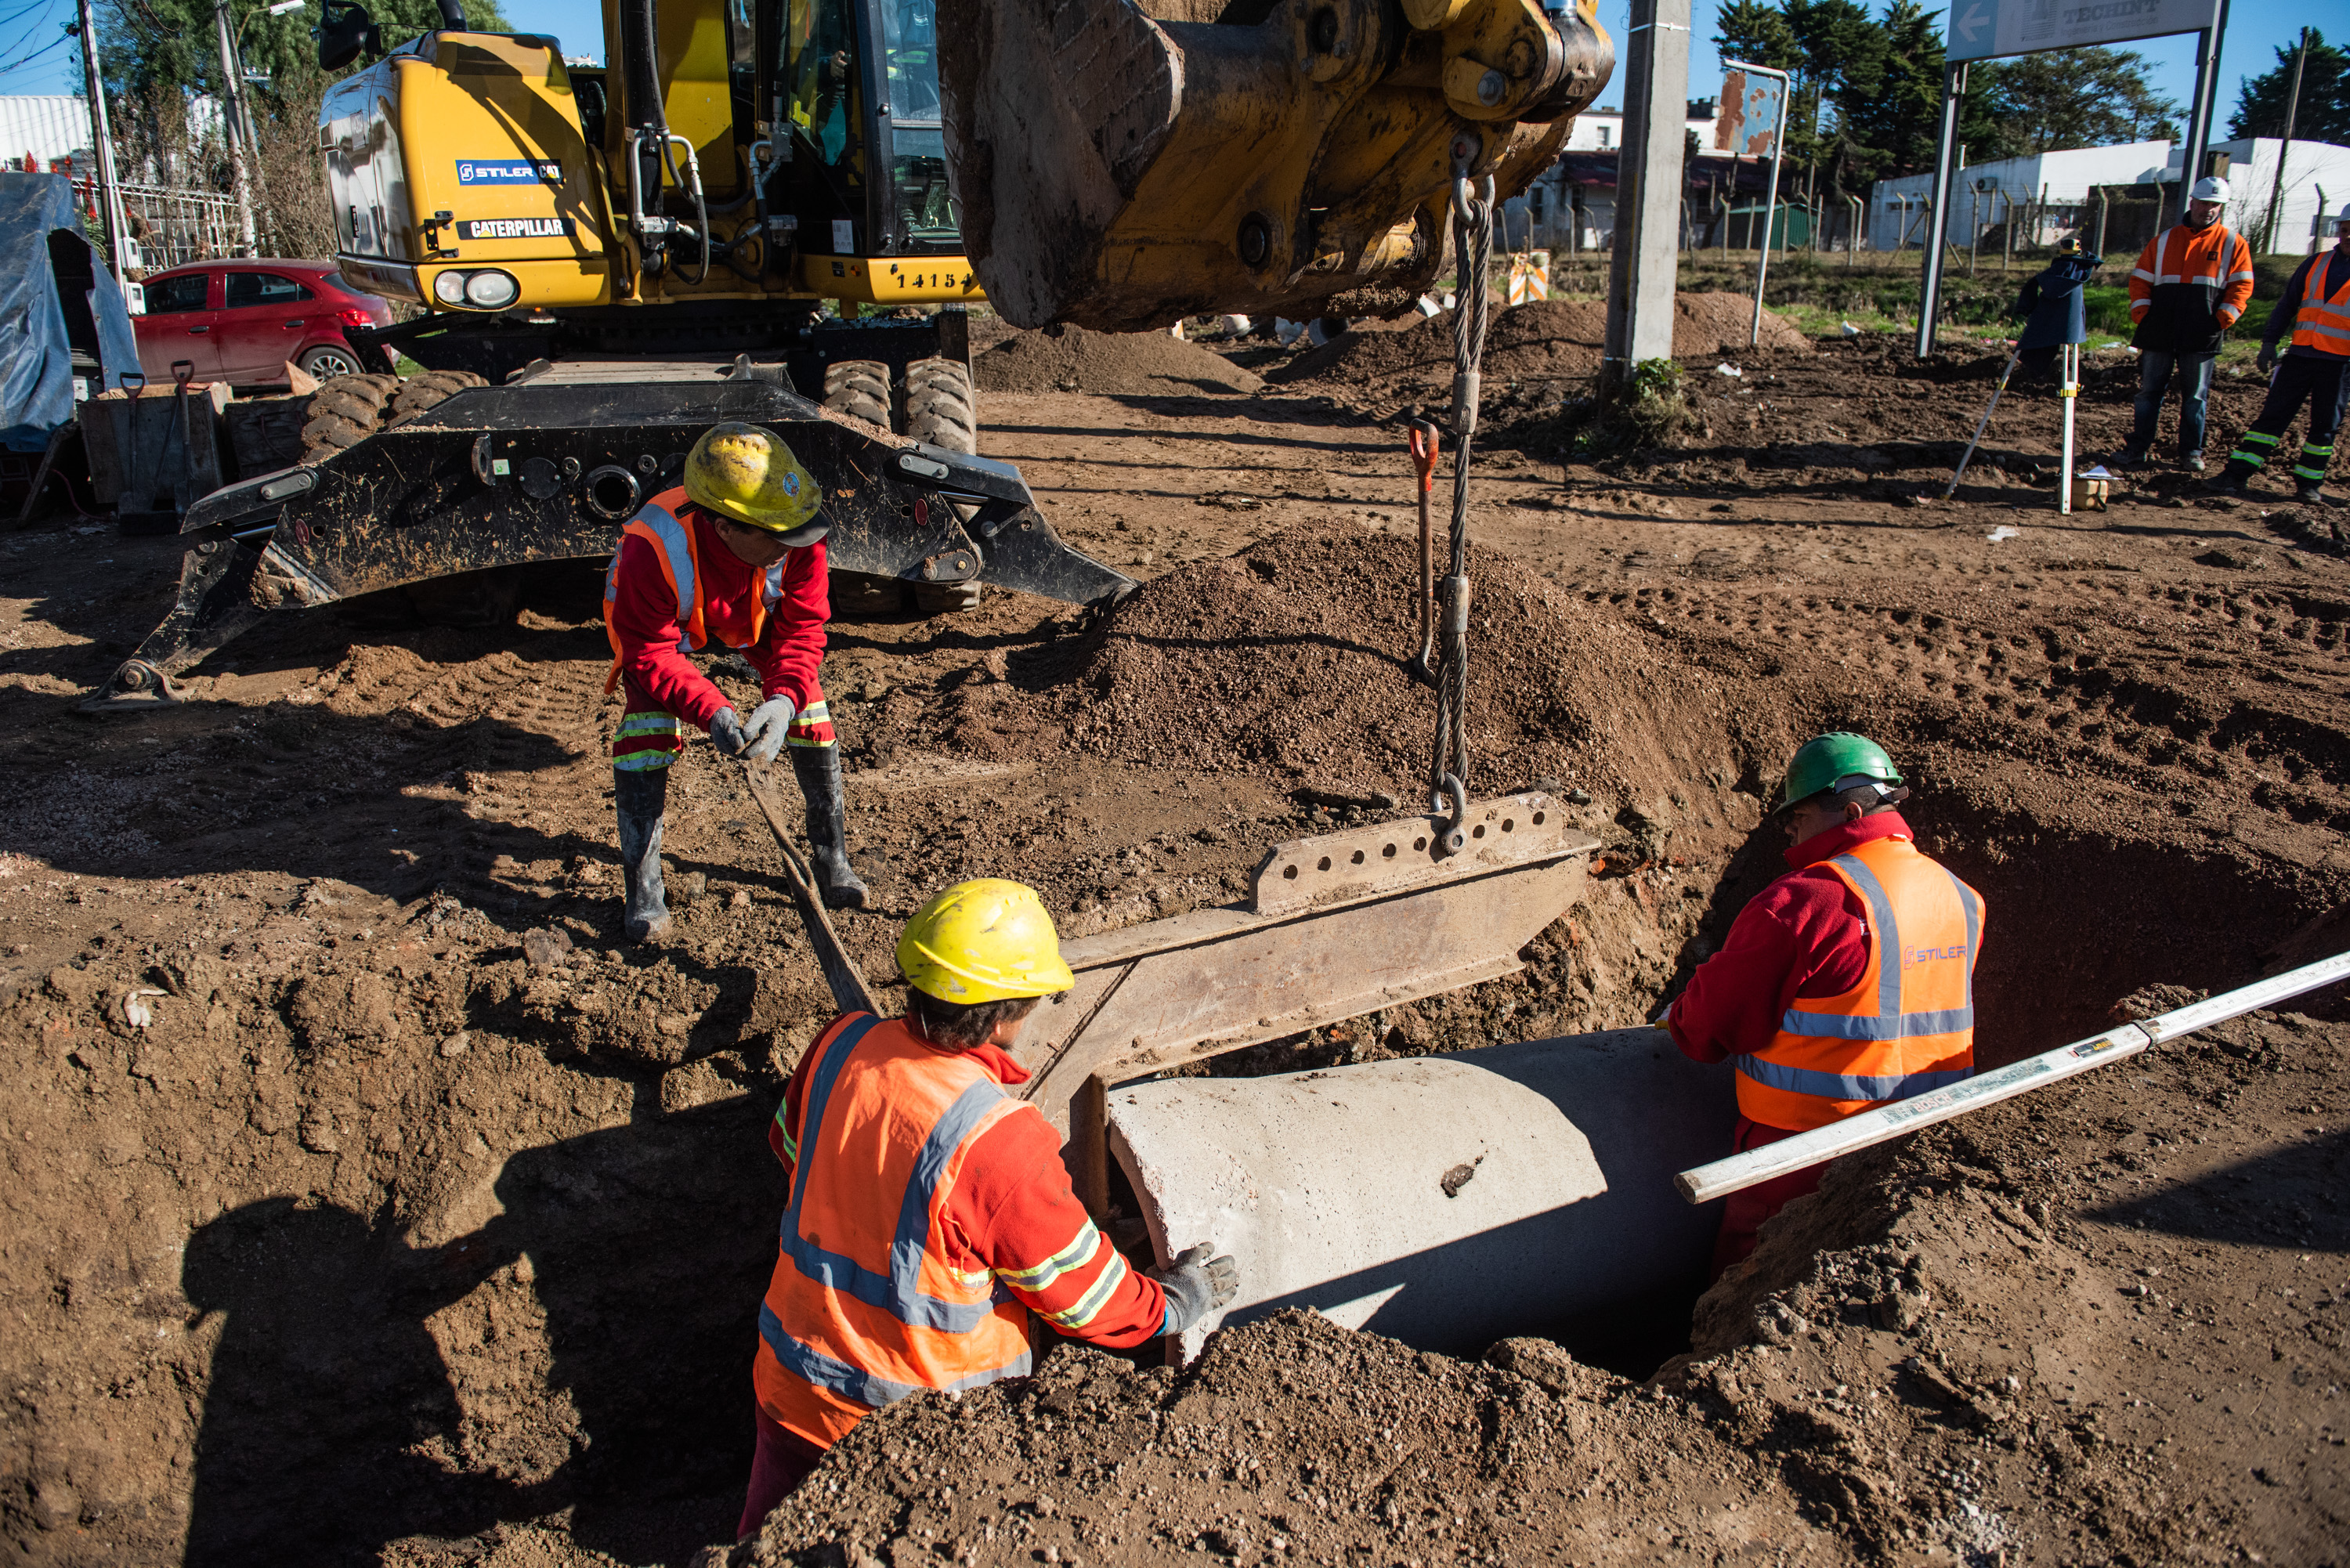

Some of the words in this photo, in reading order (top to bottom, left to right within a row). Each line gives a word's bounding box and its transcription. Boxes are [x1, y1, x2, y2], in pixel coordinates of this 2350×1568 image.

[2063, 0, 2160, 24] TECHINT
[475, 167, 534, 178] STILER
[538, 164, 560, 179] CAT
[470, 219, 564, 238] CATERPILLAR
[1917, 945, 1967, 963] STILER
[1912, 1093, 1954, 1113] BOSCH
